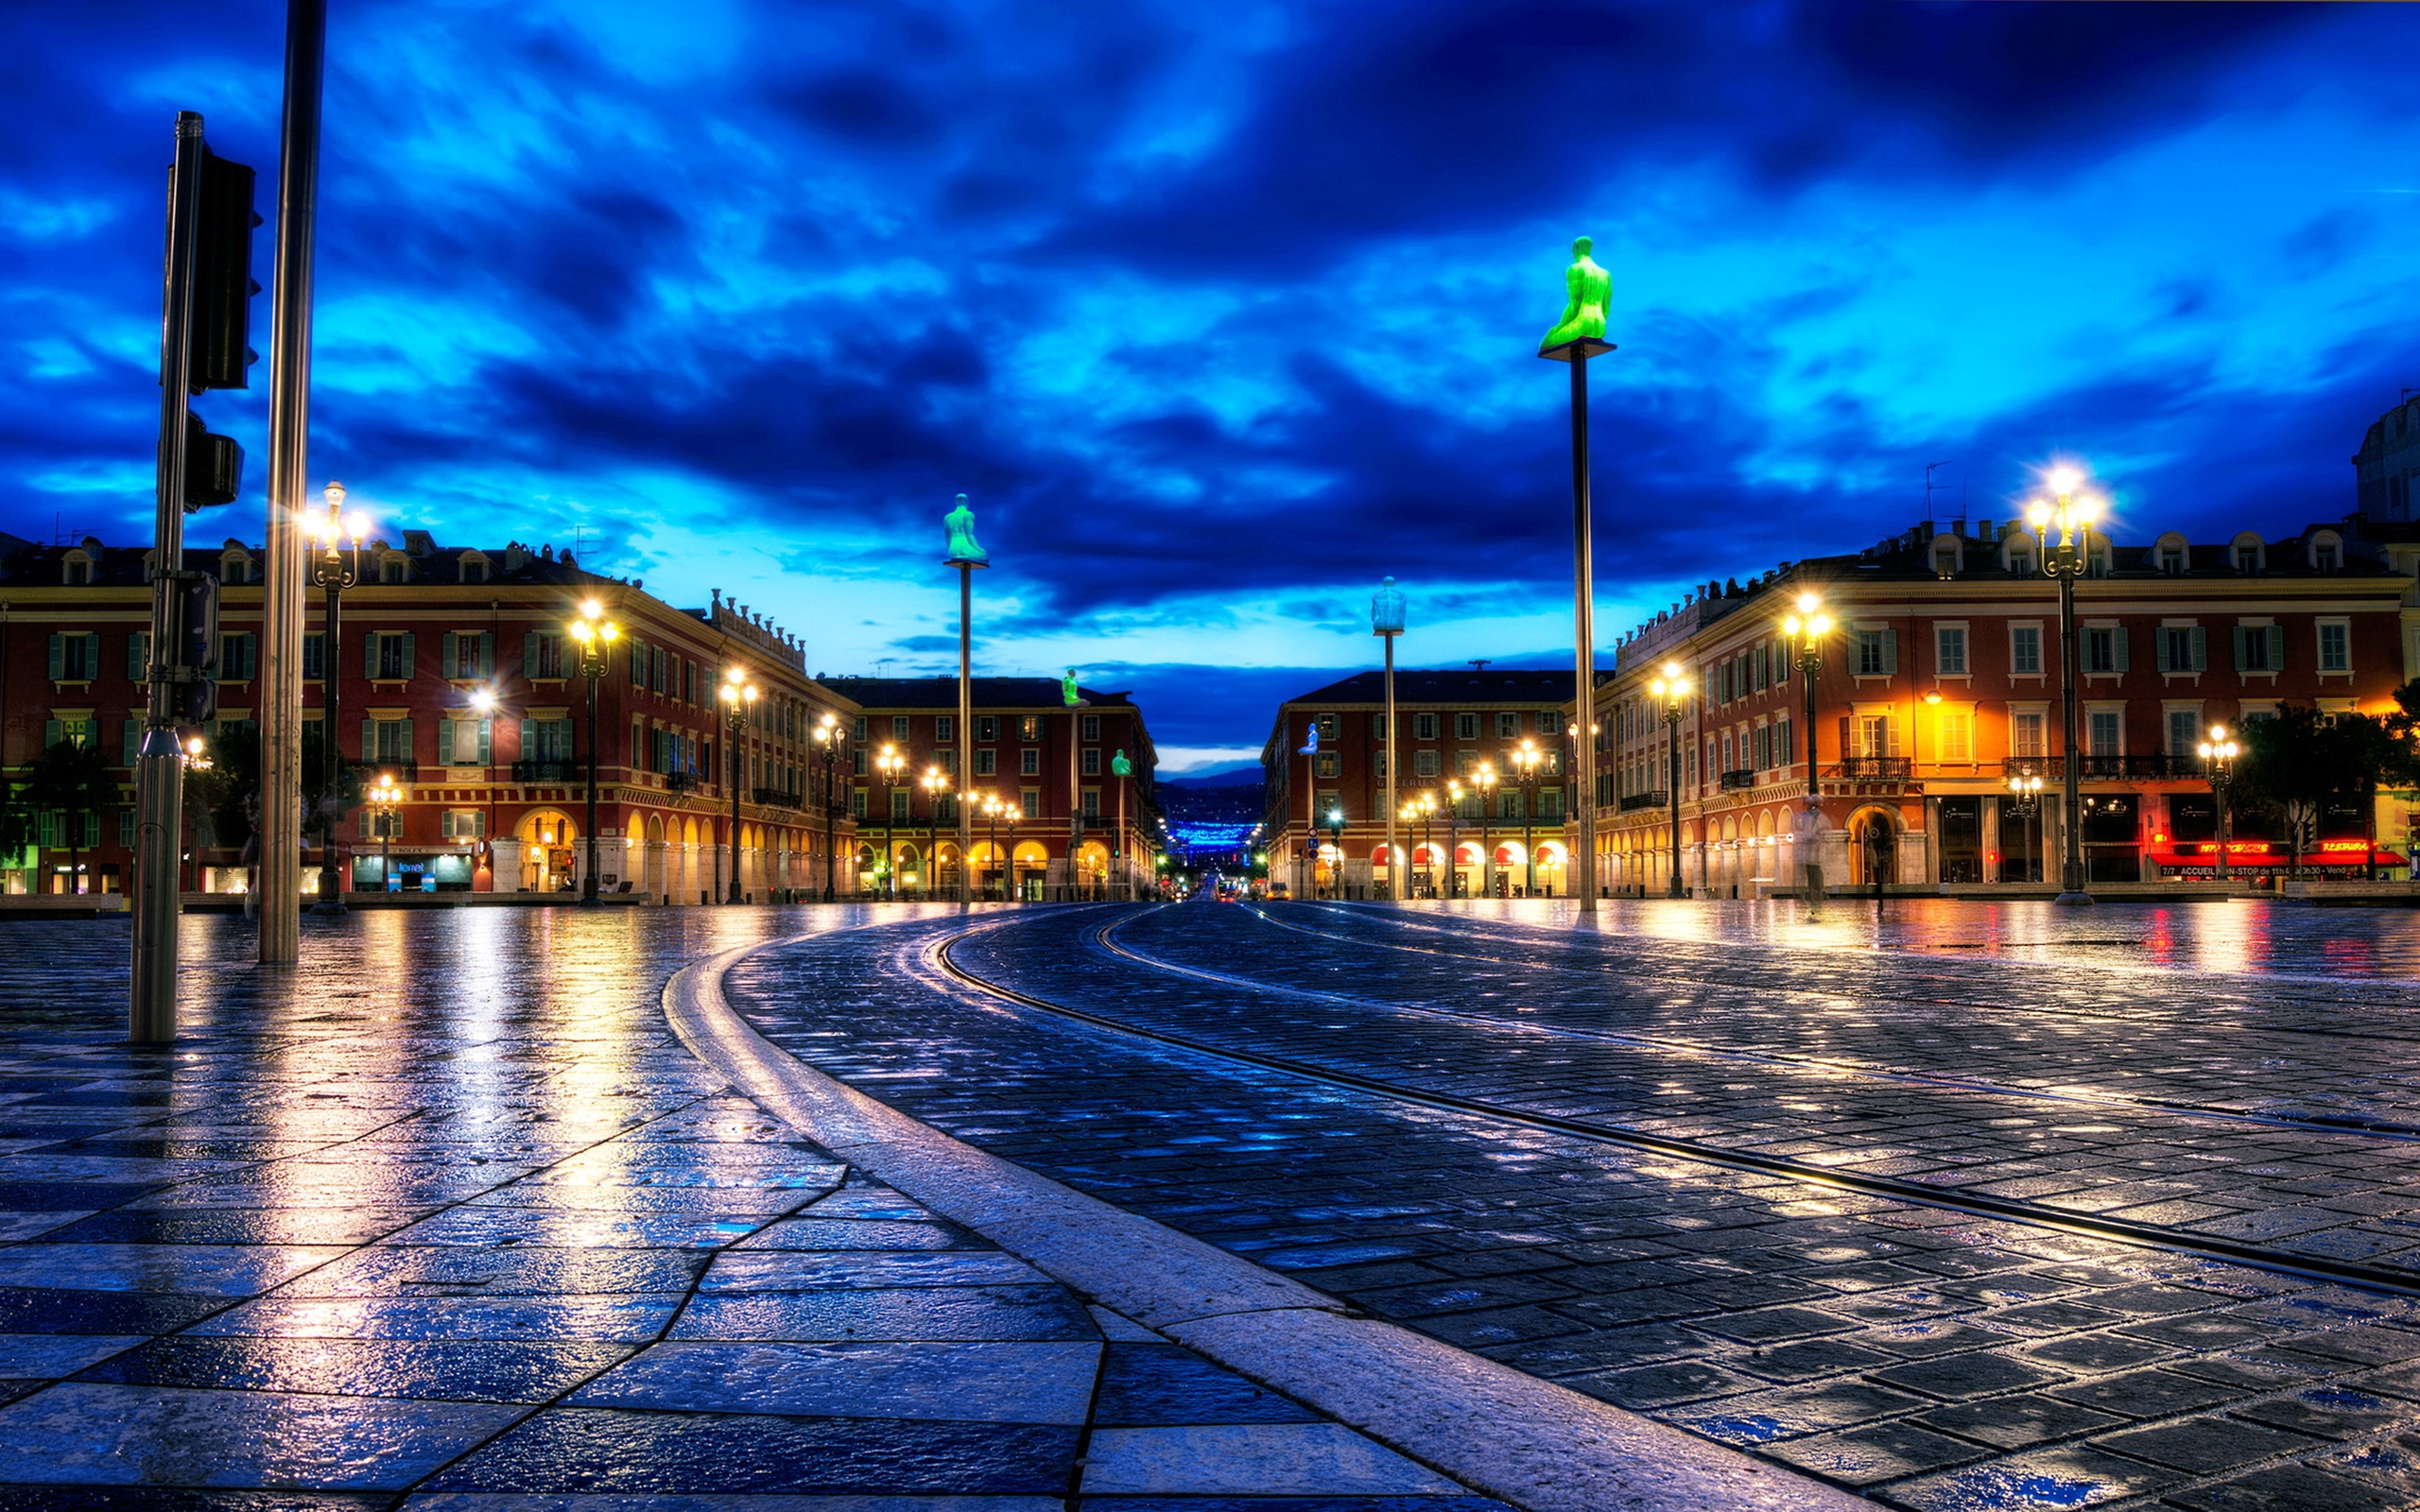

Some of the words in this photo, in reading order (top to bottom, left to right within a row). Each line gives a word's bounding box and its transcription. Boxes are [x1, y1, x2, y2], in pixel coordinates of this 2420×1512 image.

[1376, 779, 1436, 787] GLERIES
[2323, 842, 2378, 851] RESTAURA
[2162, 867, 2175, 876] 7/7
[2180, 867, 2216, 876] ACCUEIL
[2217, 867, 2259, 876] N-STOP
[2259, 867, 2270, 876] de
